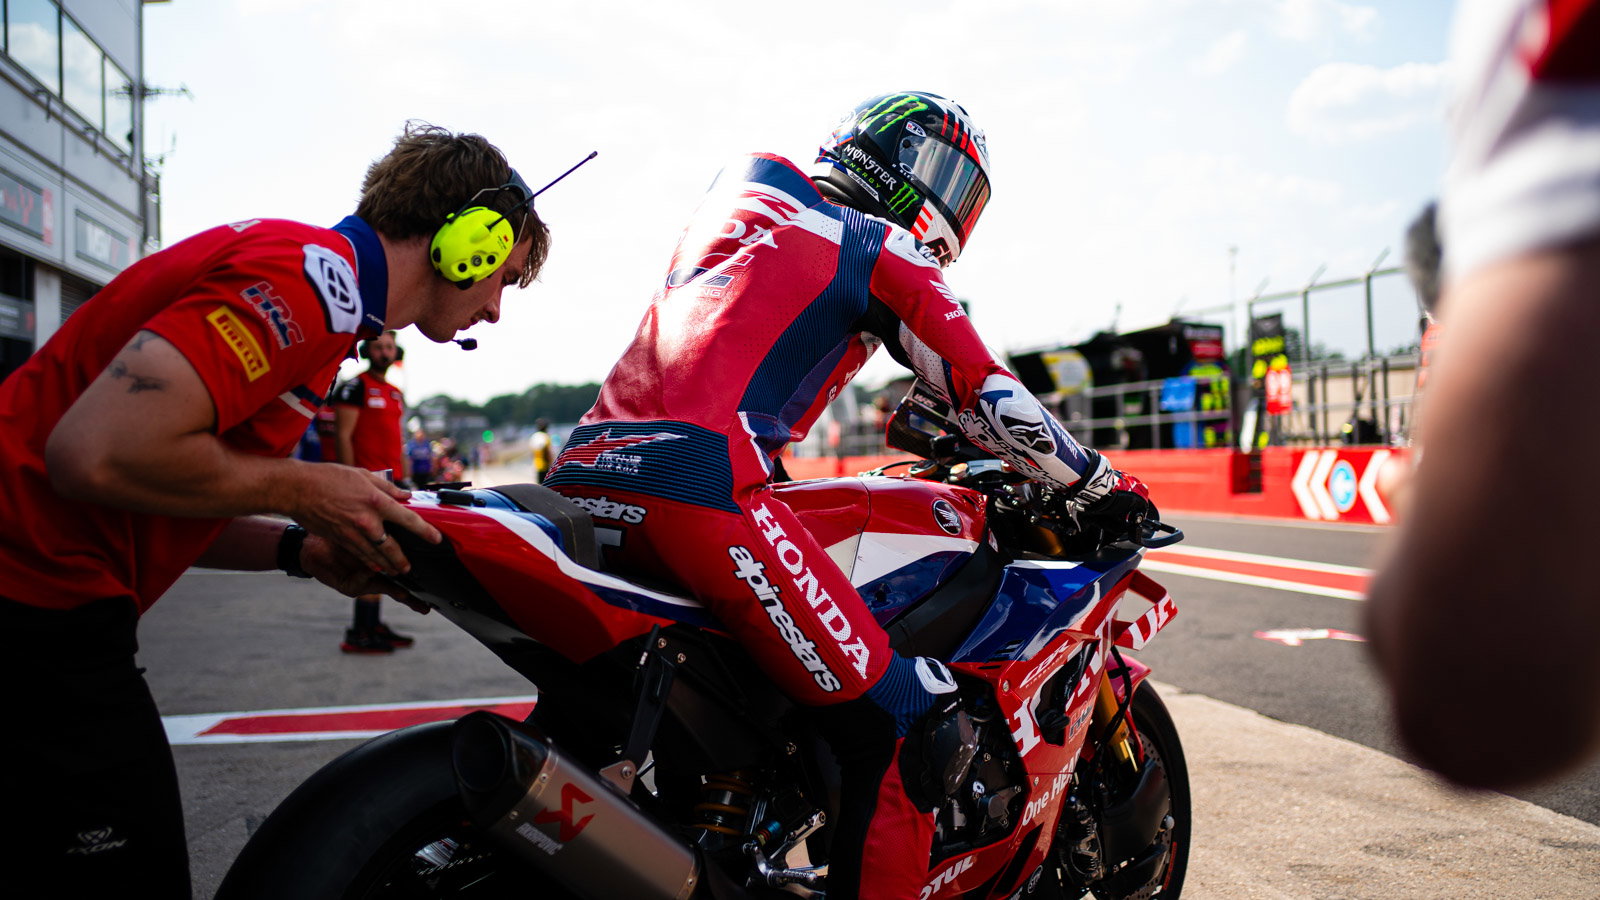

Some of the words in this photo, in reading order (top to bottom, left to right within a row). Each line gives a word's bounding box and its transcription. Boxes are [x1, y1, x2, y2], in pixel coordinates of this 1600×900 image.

[843, 159, 881, 188] ENERGY
[728, 545, 842, 693] alpinestars
[751, 503, 870, 680] HONDA
[1022, 791, 1050, 826] One
